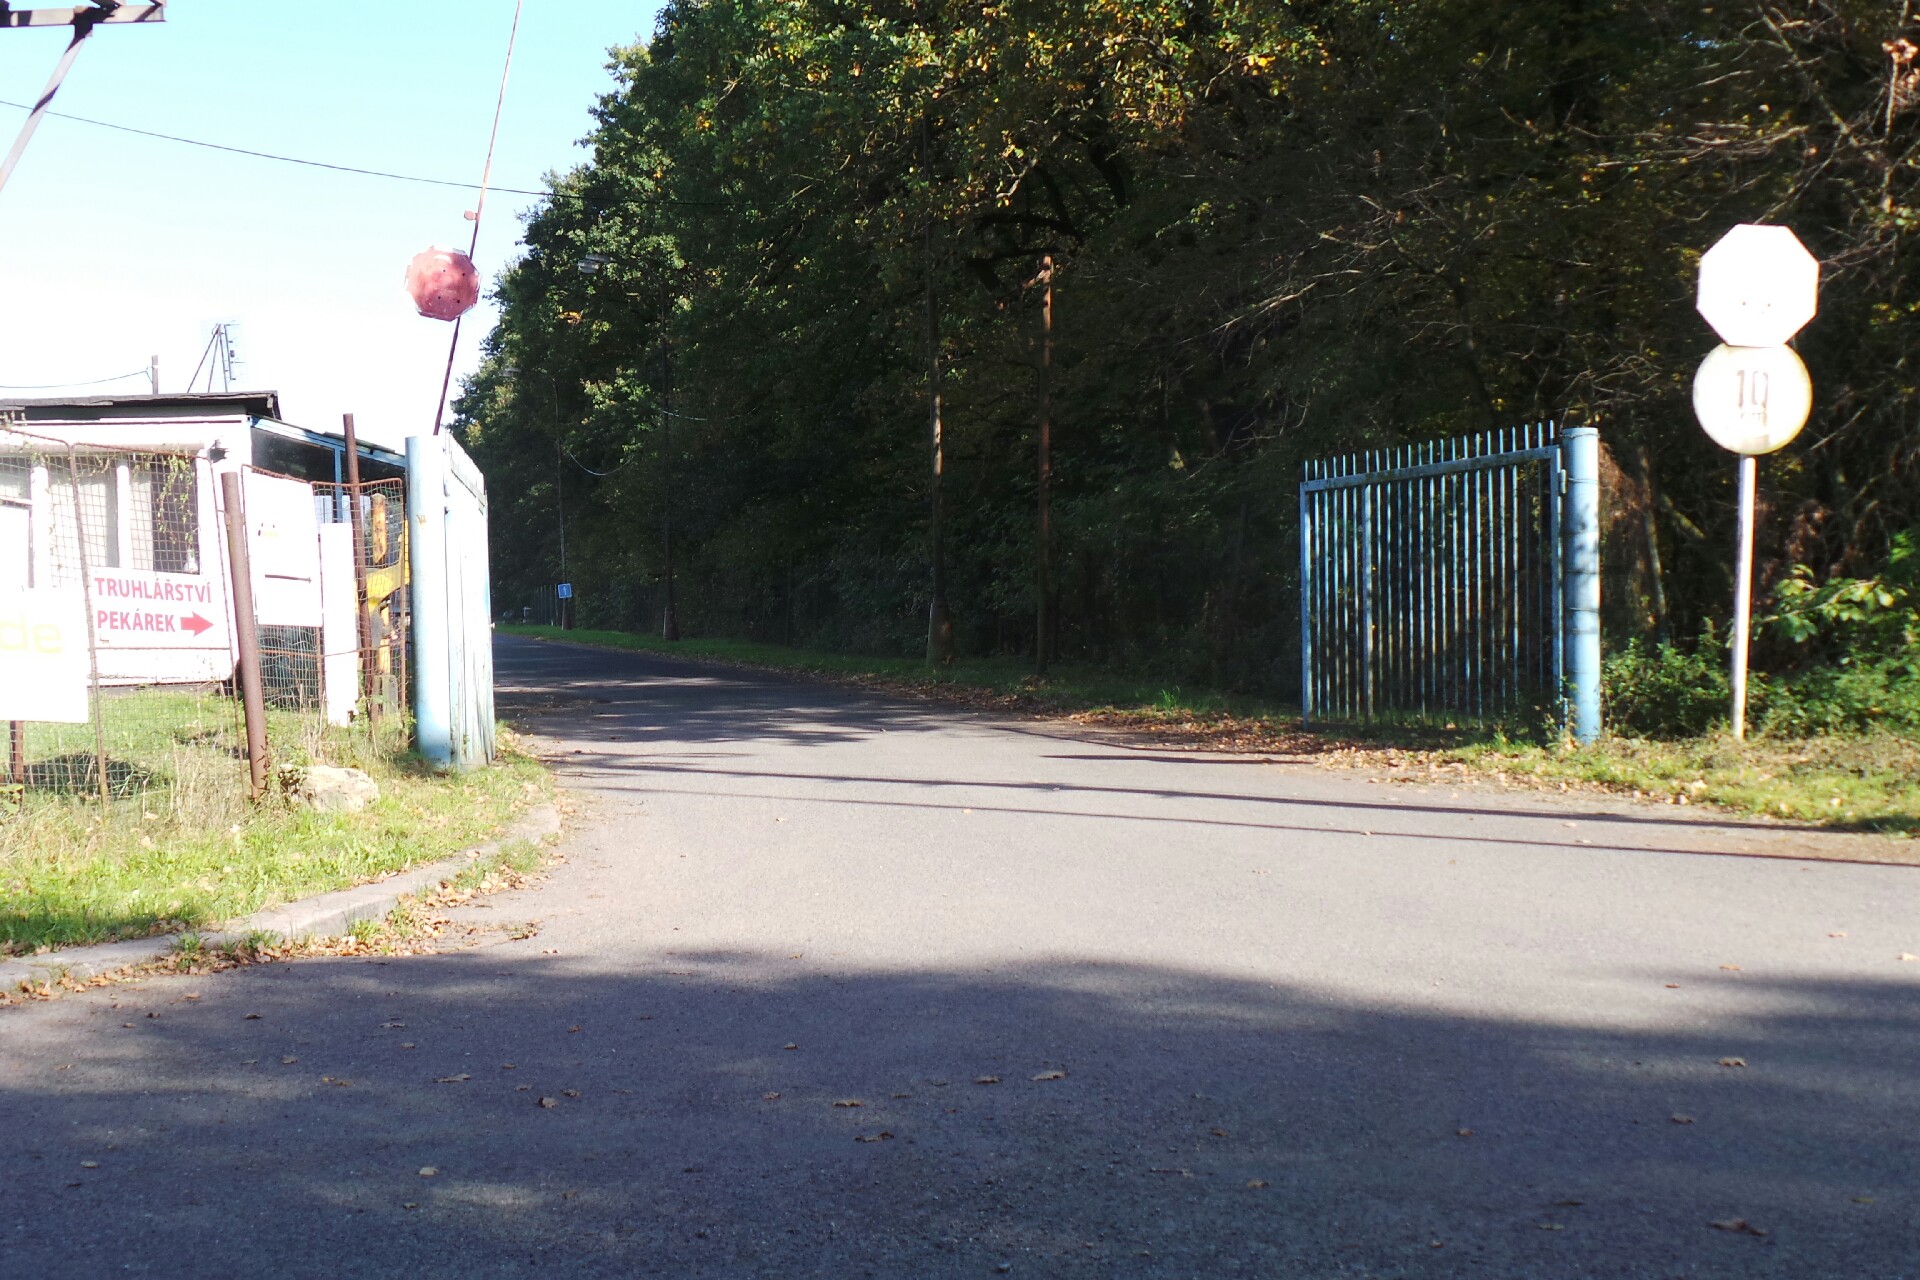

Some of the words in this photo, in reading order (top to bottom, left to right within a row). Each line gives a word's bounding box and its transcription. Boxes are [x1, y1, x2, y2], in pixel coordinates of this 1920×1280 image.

[1737, 369, 1768, 408] 10
[94, 577, 212, 603] TRUHLÁŘSTVÍ
[97, 608, 176, 633] PEKÁREK
